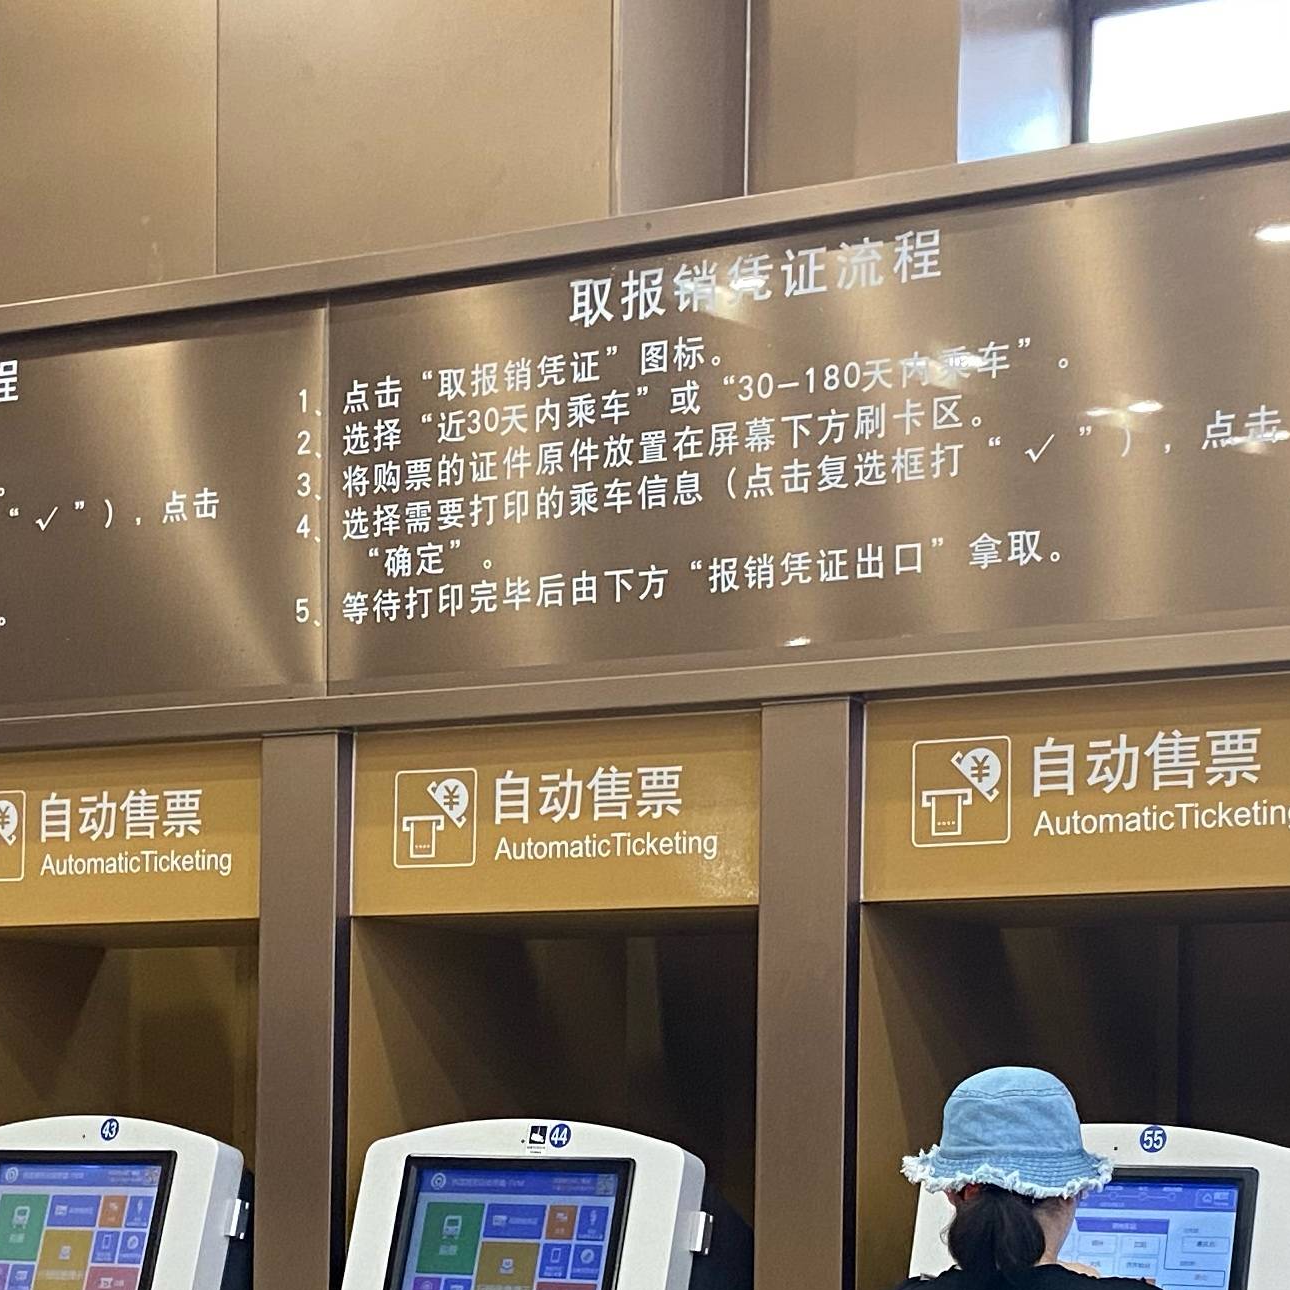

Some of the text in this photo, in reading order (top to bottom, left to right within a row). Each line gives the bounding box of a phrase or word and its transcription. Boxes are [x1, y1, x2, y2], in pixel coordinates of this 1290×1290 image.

[569, 229, 942, 328] 取报销凭证流程
[1033, 728, 1262, 798] 自动售票
[493, 764, 685, 827] 自动售票
[38, 787, 203, 843] 自动售票
[495, 830, 718, 861] AutomaticTicketing
[39, 848, 232, 876] AutomaticTicketing
[101, 1120, 119, 1140] 43
[551, 1126, 570, 1146] 44
[1142, 1130, 1165, 1151] 55
